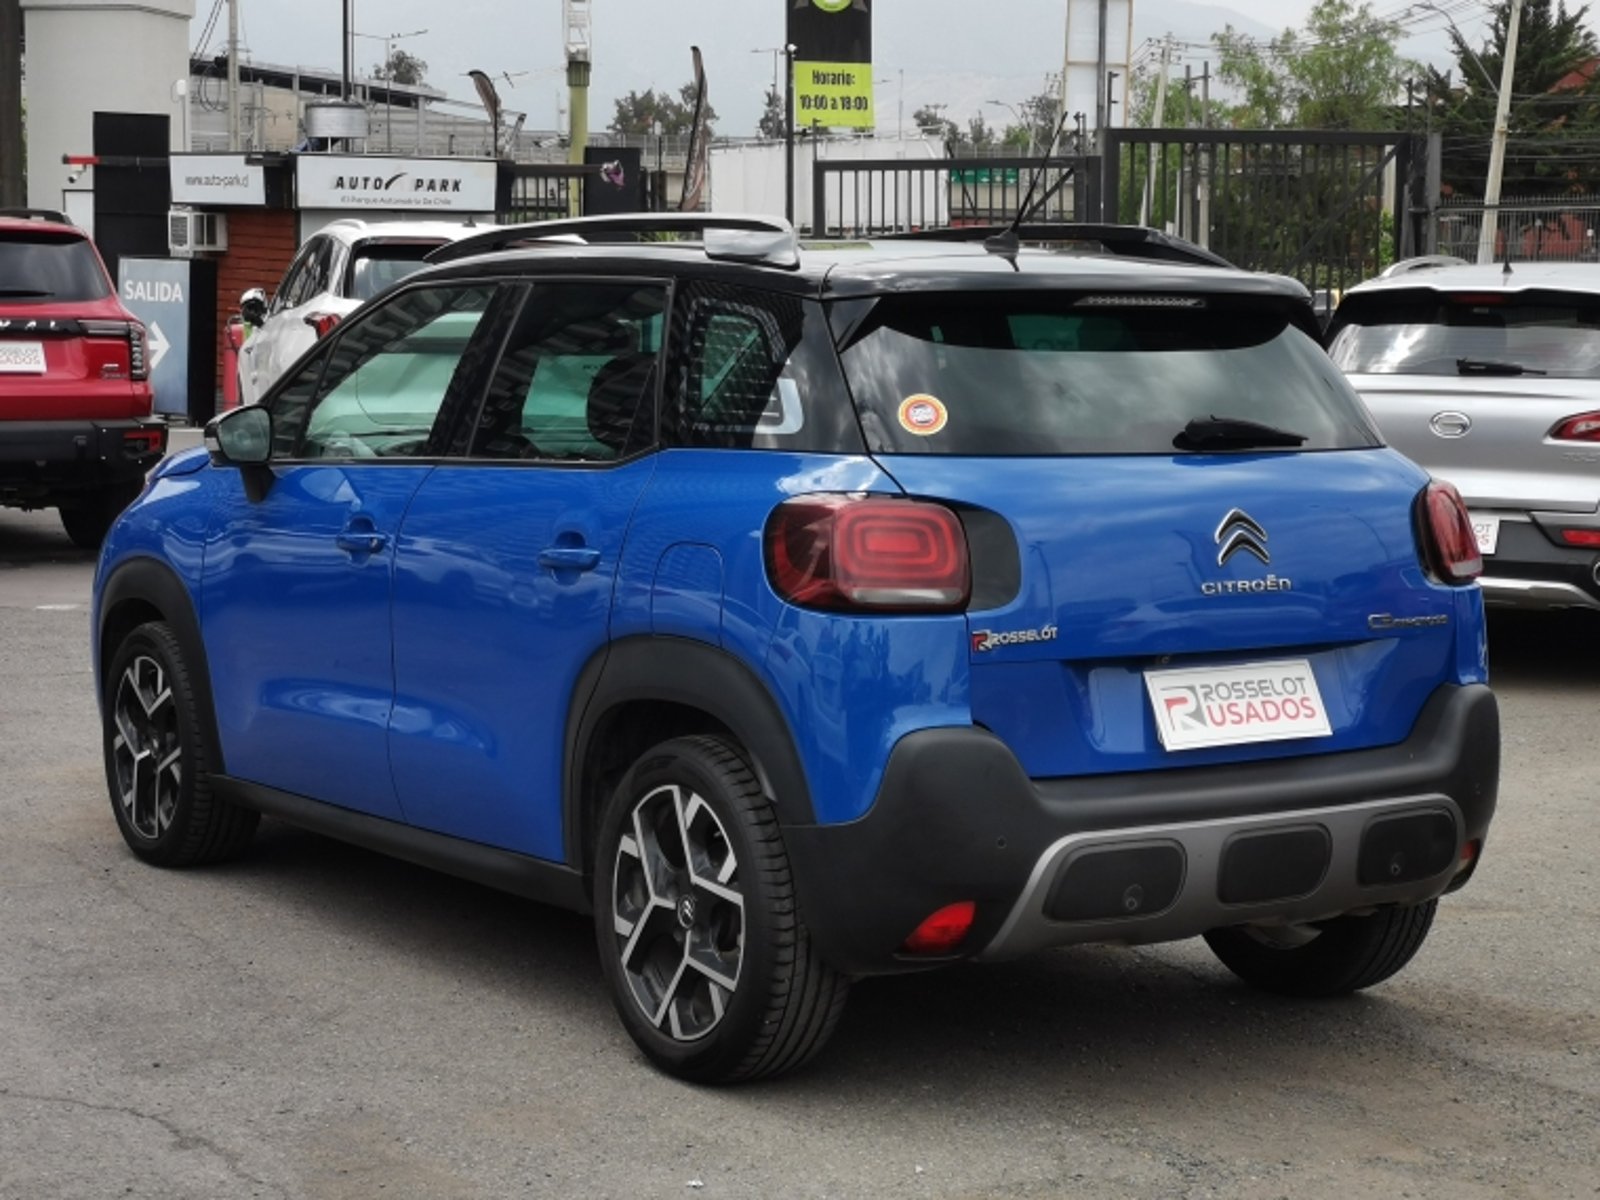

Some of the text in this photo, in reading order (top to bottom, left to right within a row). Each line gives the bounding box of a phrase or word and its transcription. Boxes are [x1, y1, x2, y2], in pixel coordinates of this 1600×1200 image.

[812, 69, 856, 86] Horario:
[800, 94, 829, 110] 10:00
[831, 97, 838, 110] a
[334, 175, 462, 193] AUTO PARK
[125, 279, 184, 303] SALIDA
[1200, 677, 1306, 702] ROSSELOT
[1206, 697, 1317, 727] USADOS
